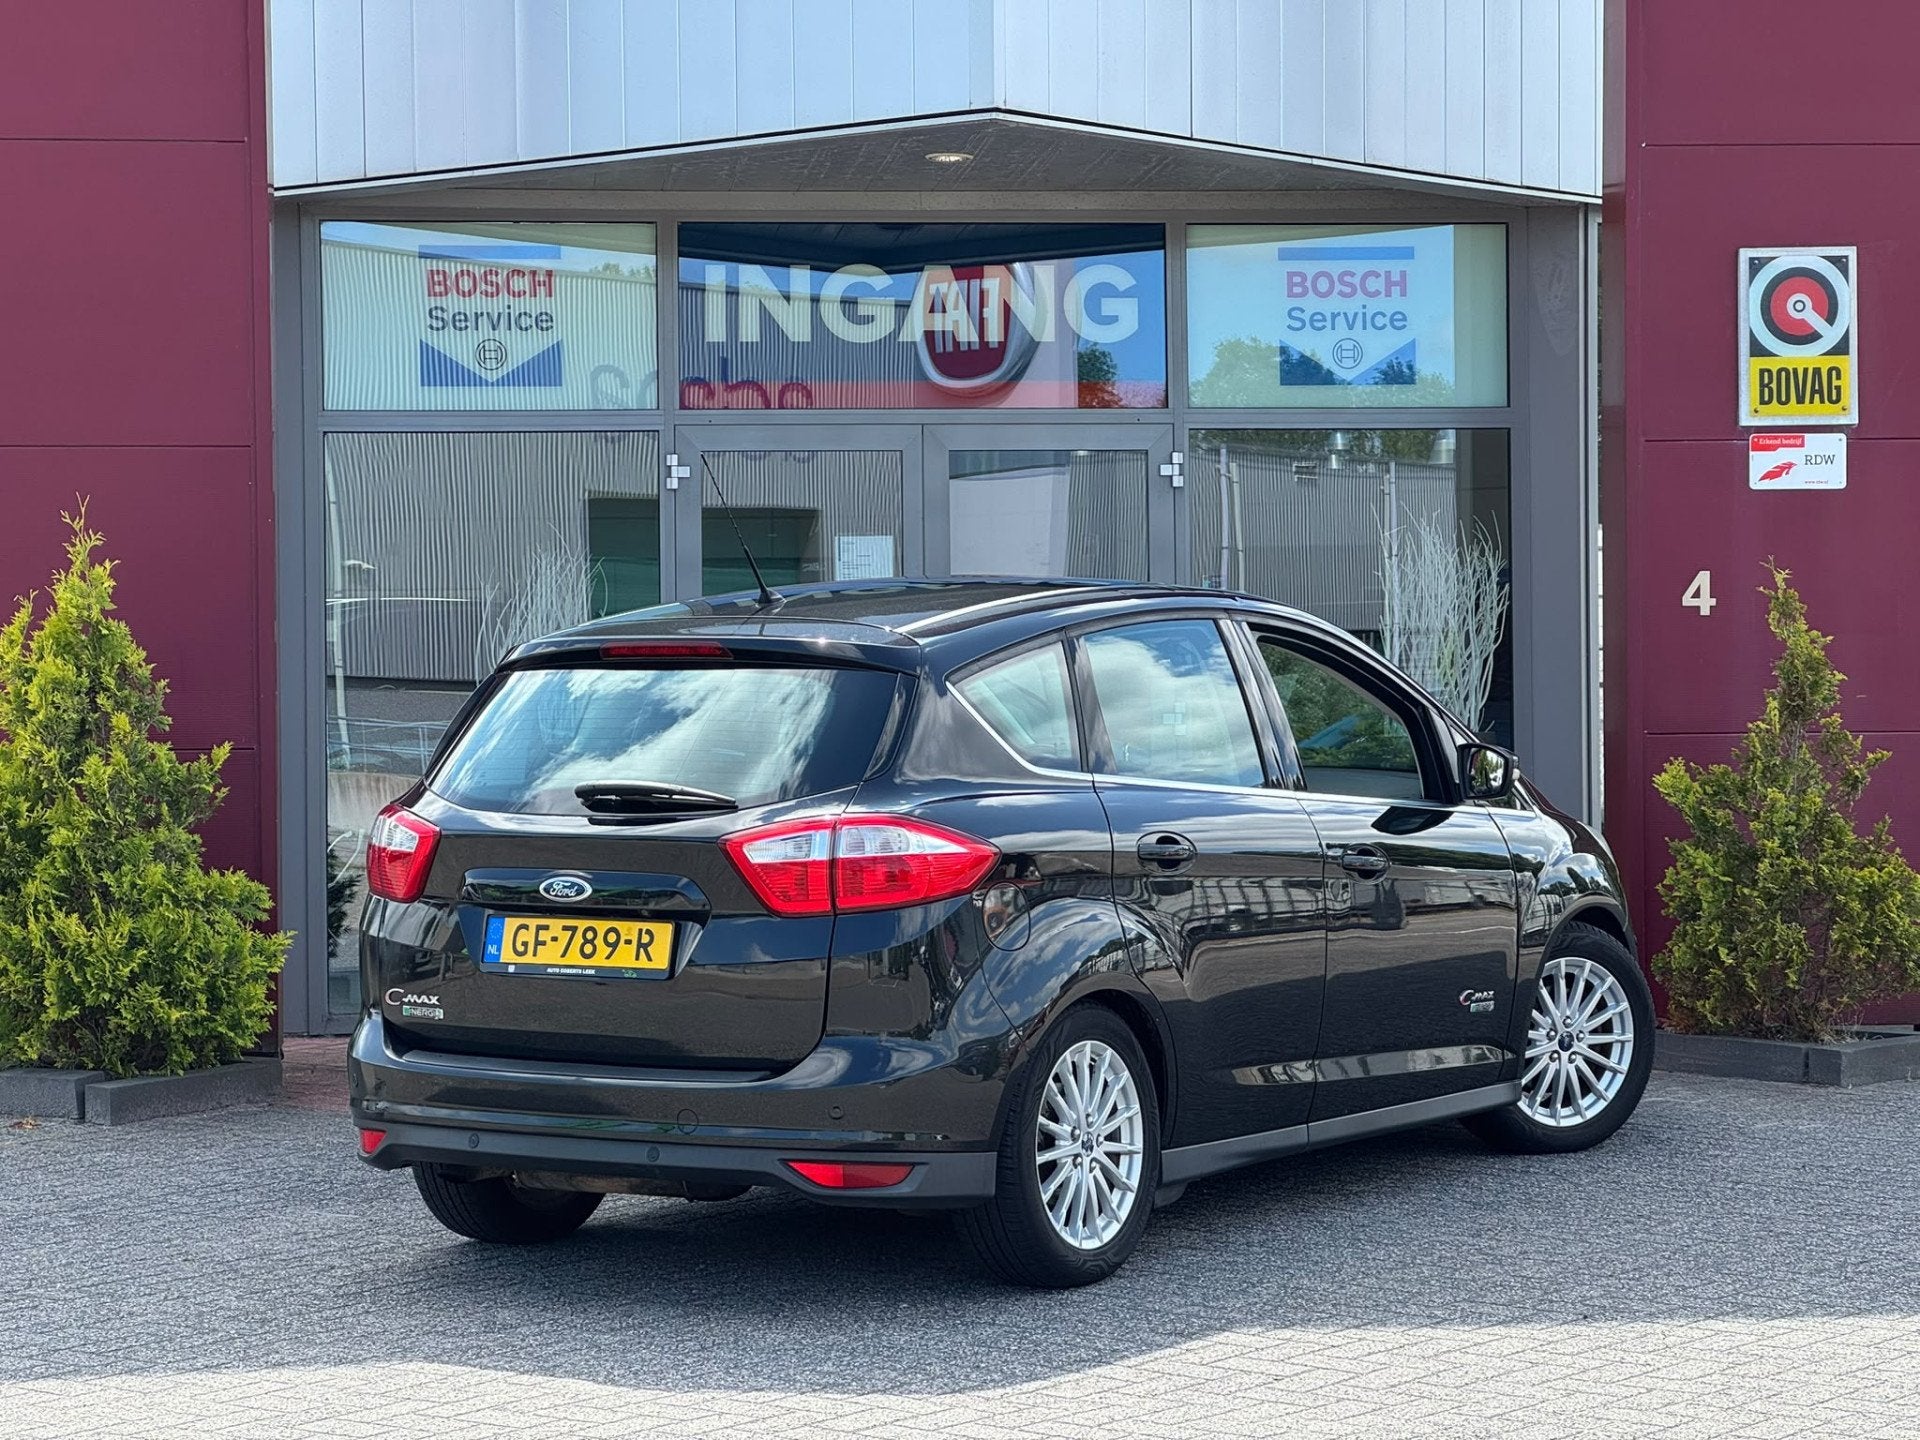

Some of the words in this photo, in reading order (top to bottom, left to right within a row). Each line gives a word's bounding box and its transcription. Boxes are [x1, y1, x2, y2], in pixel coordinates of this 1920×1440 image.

[427, 268, 554, 298] BOSCH
[1286, 270, 1407, 298] BOSCH
[427, 304, 554, 331] Service
[704, 264, 1140, 343] INGANG
[1286, 304, 1408, 331] Service
[1758, 366, 1842, 406] BOVAG
[1804, 454, 1836, 466] RDW
[1682, 570, 1717, 616] 4
[550, 880, 579, 897] Ford
[487, 944, 500, 956] NL
[512, 923, 655, 962] GF-789-R
